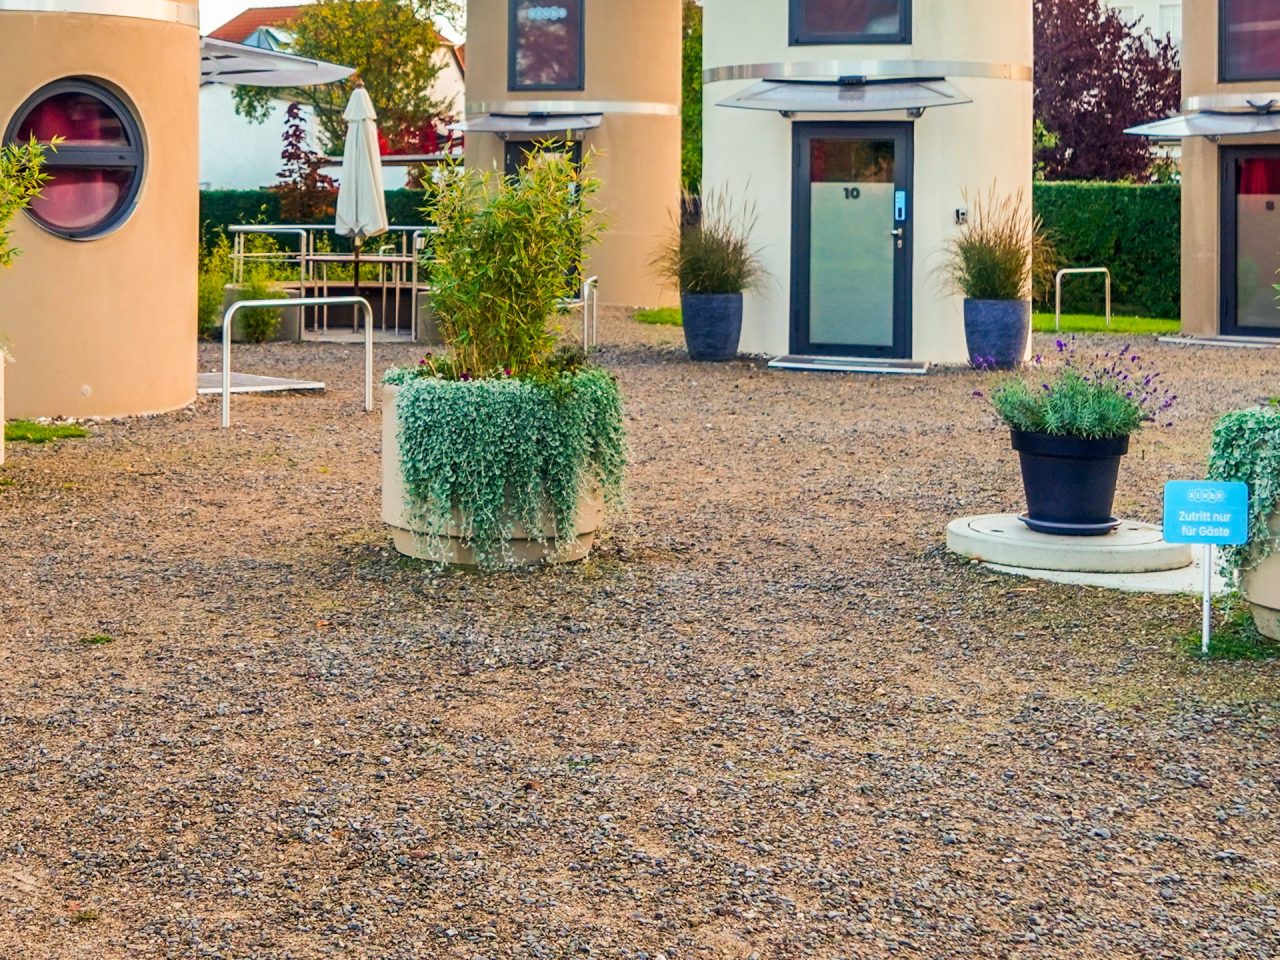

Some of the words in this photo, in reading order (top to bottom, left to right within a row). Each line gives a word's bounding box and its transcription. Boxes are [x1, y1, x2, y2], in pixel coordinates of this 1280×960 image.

[843, 187, 860, 200] 10
[1178, 511, 1210, 522] Zutritt
[1212, 512, 1231, 522] nur
[1181, 525, 1197, 537] für
[1199, 525, 1230, 537] Gäste
